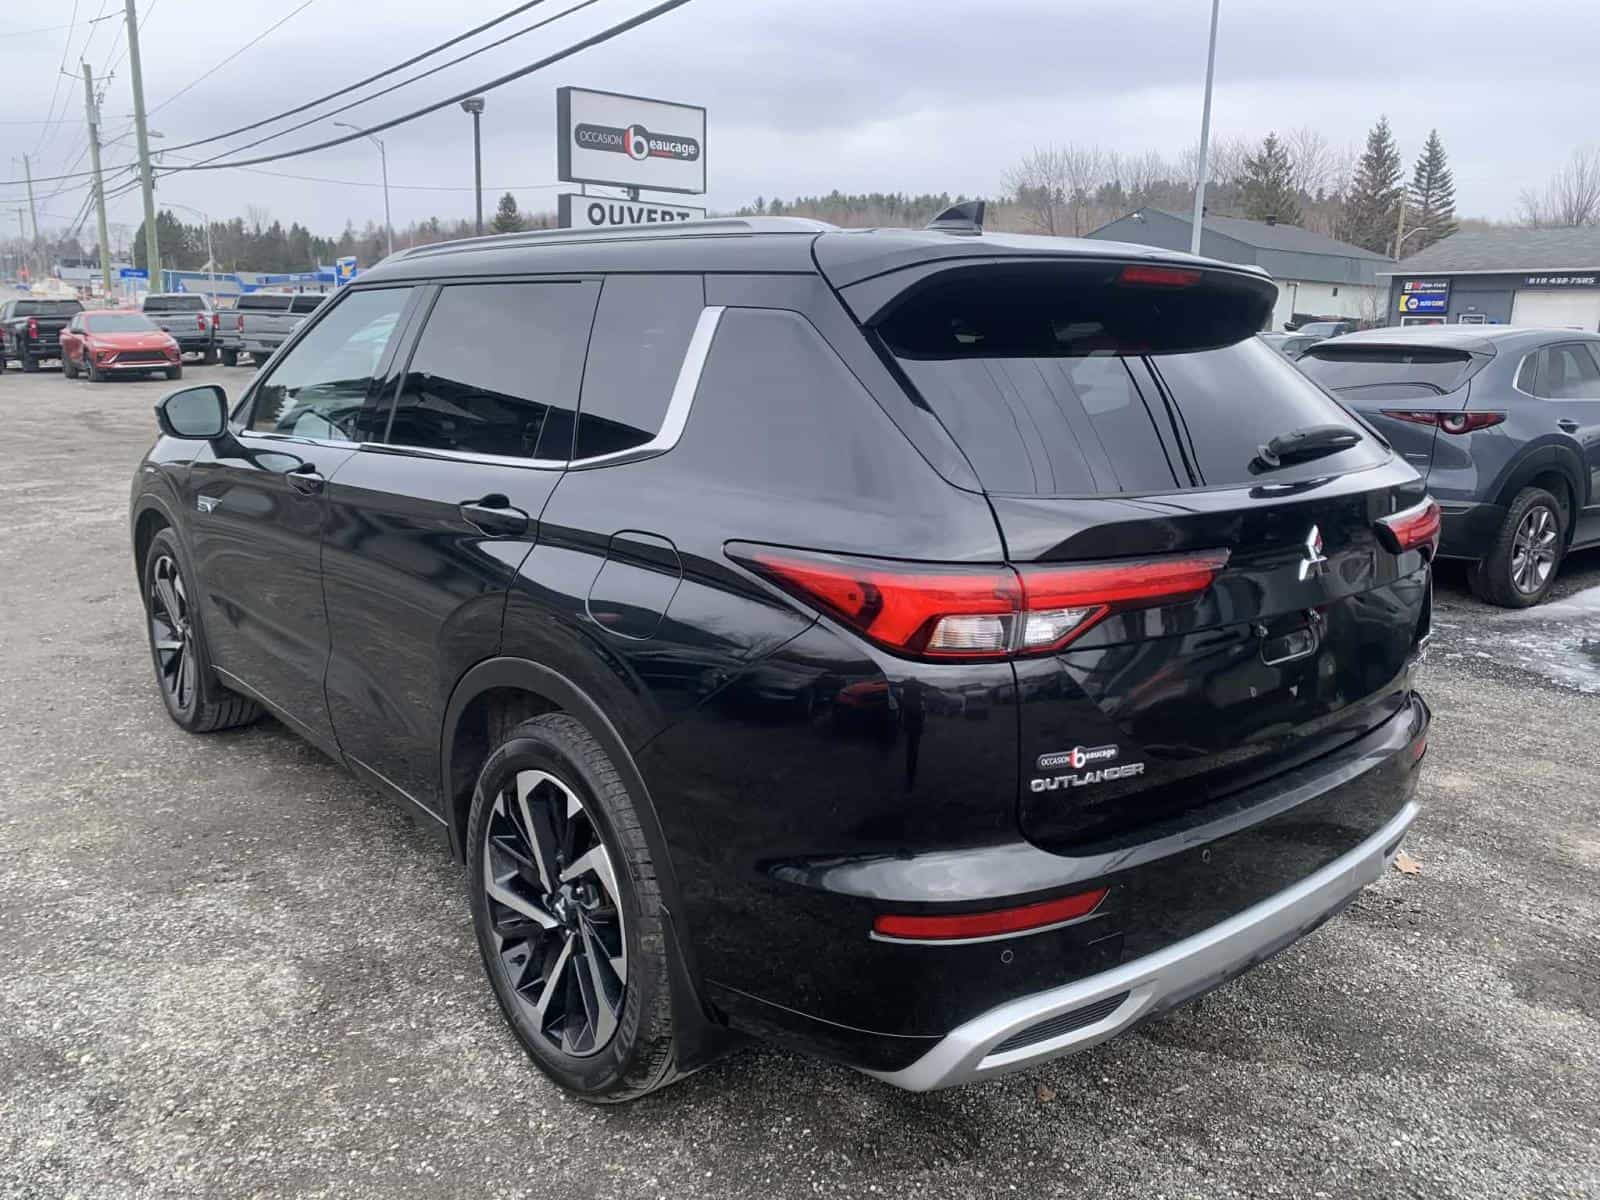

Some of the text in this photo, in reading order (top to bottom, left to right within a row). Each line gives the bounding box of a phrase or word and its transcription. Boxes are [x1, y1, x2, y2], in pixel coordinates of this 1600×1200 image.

[579, 130, 623, 145] OCCASION
[1040, 756, 1070, 767] OCCASION
[1030, 762, 1145, 793] OUTLANDER
